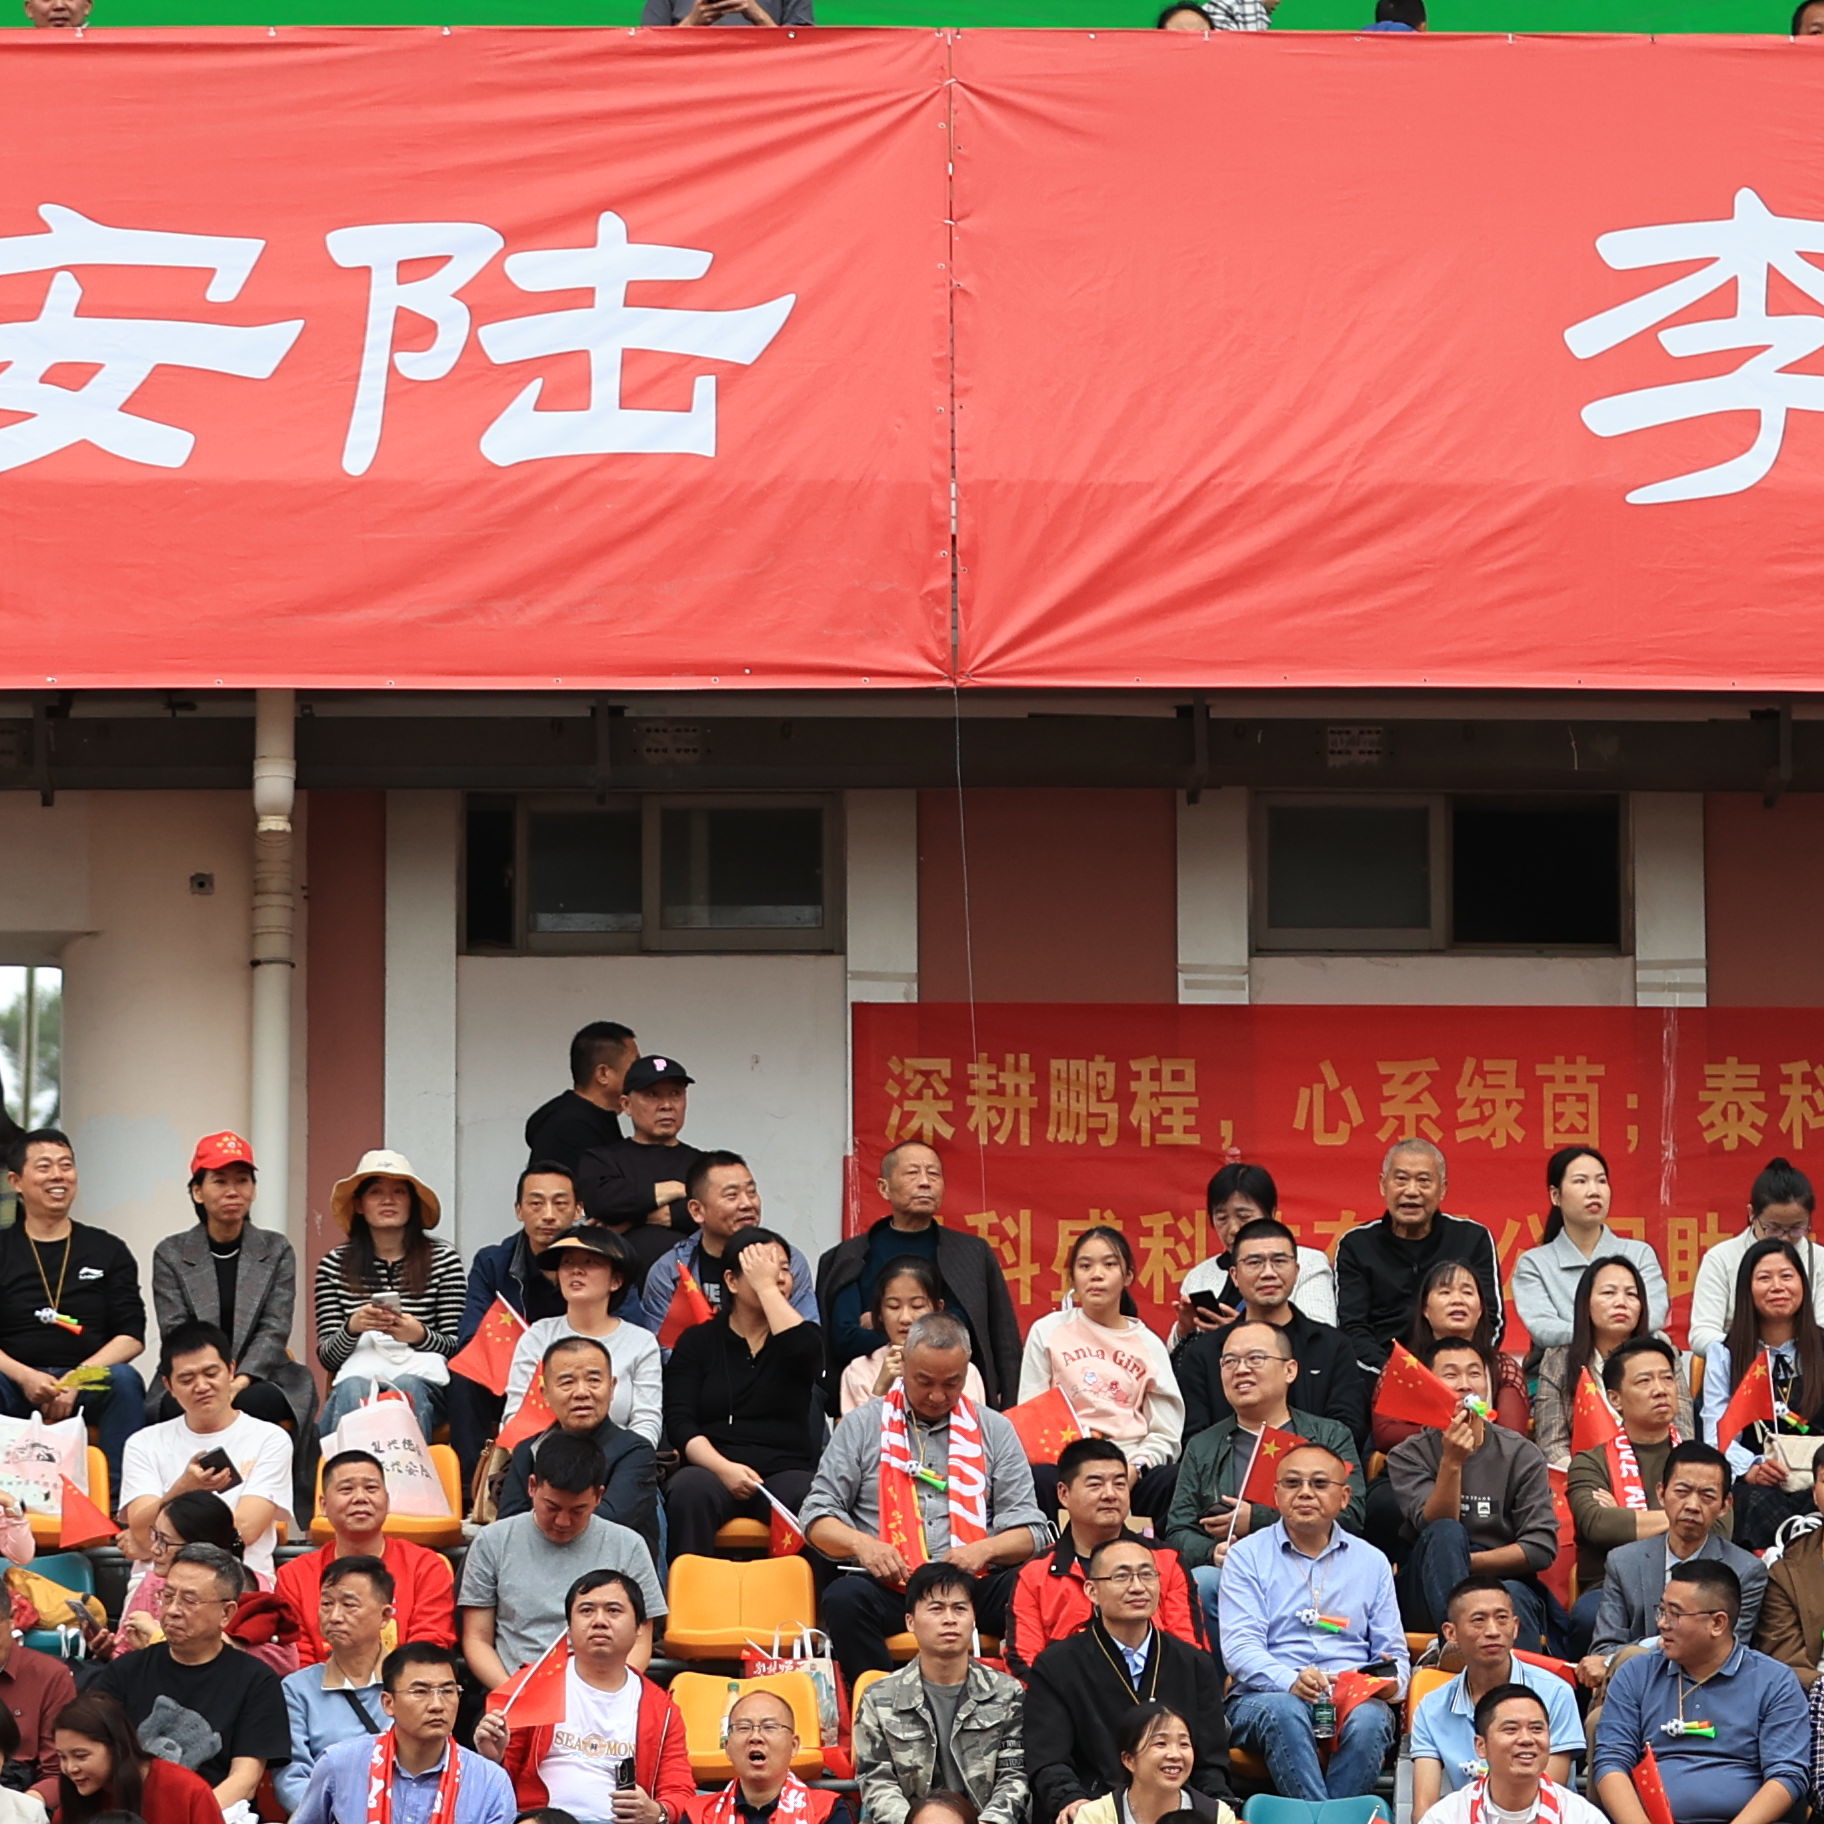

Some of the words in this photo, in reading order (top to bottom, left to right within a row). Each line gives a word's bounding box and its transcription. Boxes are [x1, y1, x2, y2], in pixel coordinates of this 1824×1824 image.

[1061, 1346, 1106, 1367] Anta
[1112, 1349, 1147, 1382] Girl
[553, 1730, 583, 1751] SEA
